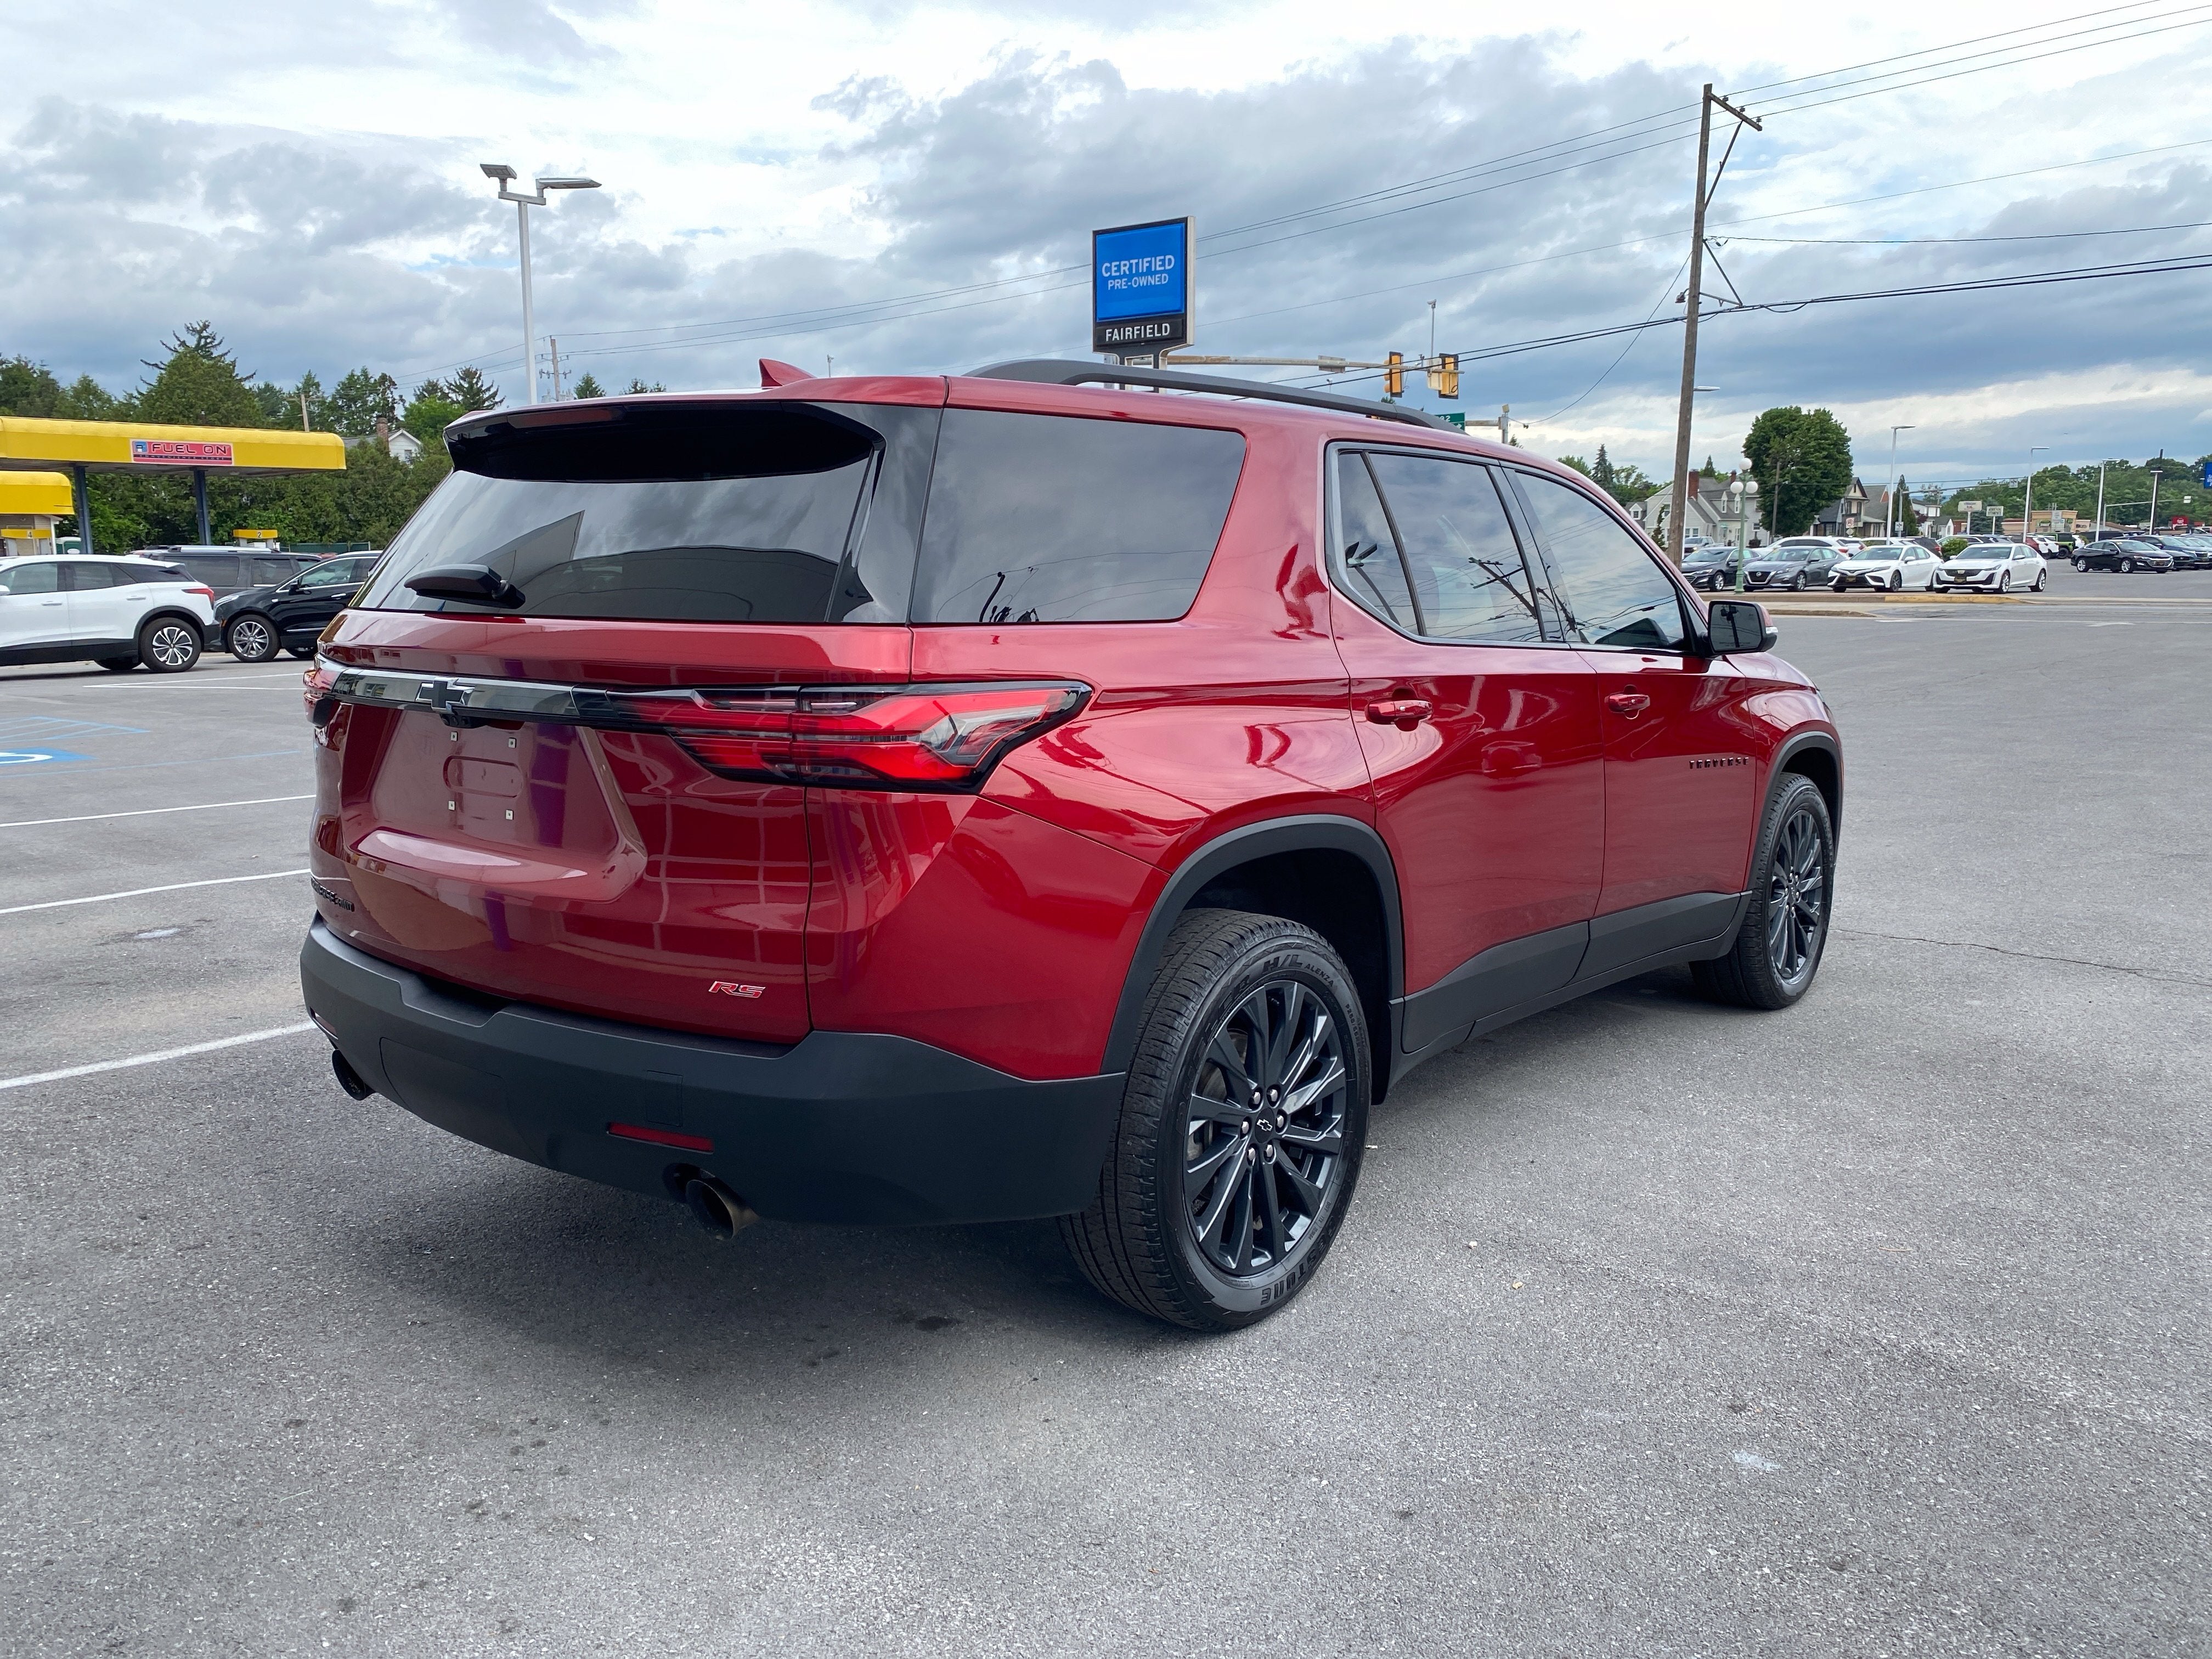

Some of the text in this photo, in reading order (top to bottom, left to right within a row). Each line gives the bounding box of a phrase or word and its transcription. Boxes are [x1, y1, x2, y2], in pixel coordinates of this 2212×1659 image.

[1102, 255, 1175, 278] CERTIFIED
[1108, 273, 1169, 291] PRE-OWNED
[1105, 323, 1170, 342] FAIRFIELD
[152, 443, 227, 454] FUEL ON
[1689, 757, 1749, 769] TRAVERSE
[1262, 954, 1304, 975] H/L
[1305, 963, 1335, 987] ALENZA
[708, 981, 766, 998] RS
